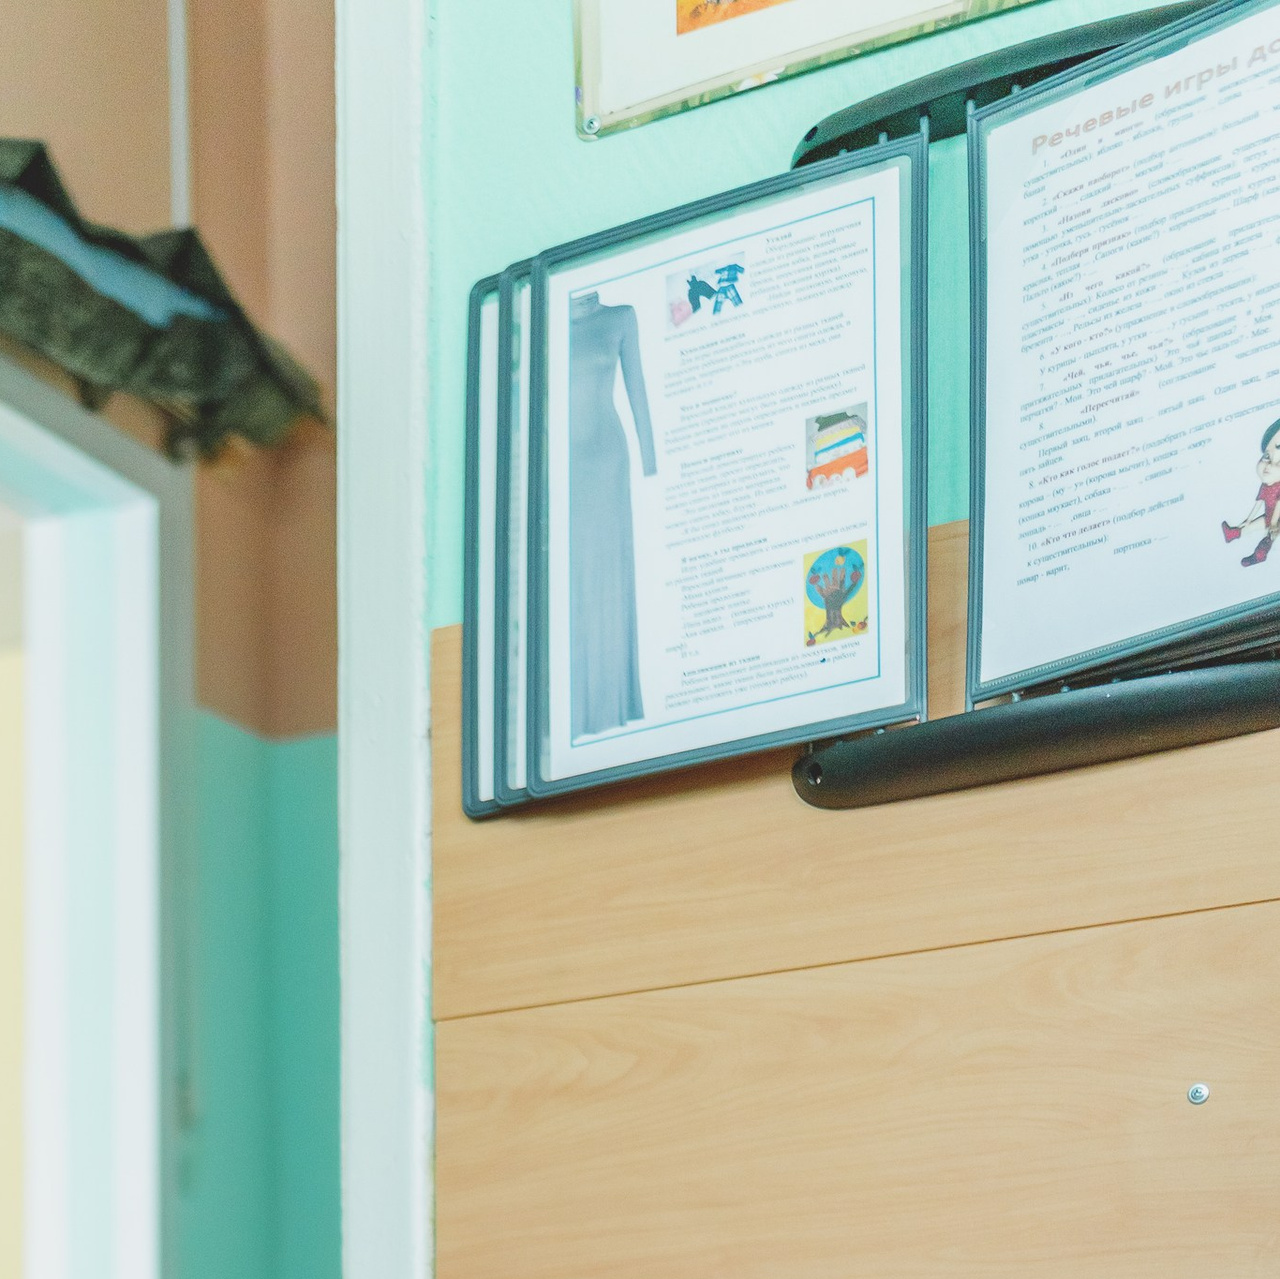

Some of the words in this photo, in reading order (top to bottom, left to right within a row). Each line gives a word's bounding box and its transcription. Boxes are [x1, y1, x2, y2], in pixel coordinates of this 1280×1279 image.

[1031, 91, 1153, 157] Речевые
[1164, 55, 1237, 100] игры
[1040, 534, 1060, 548] «Кто
